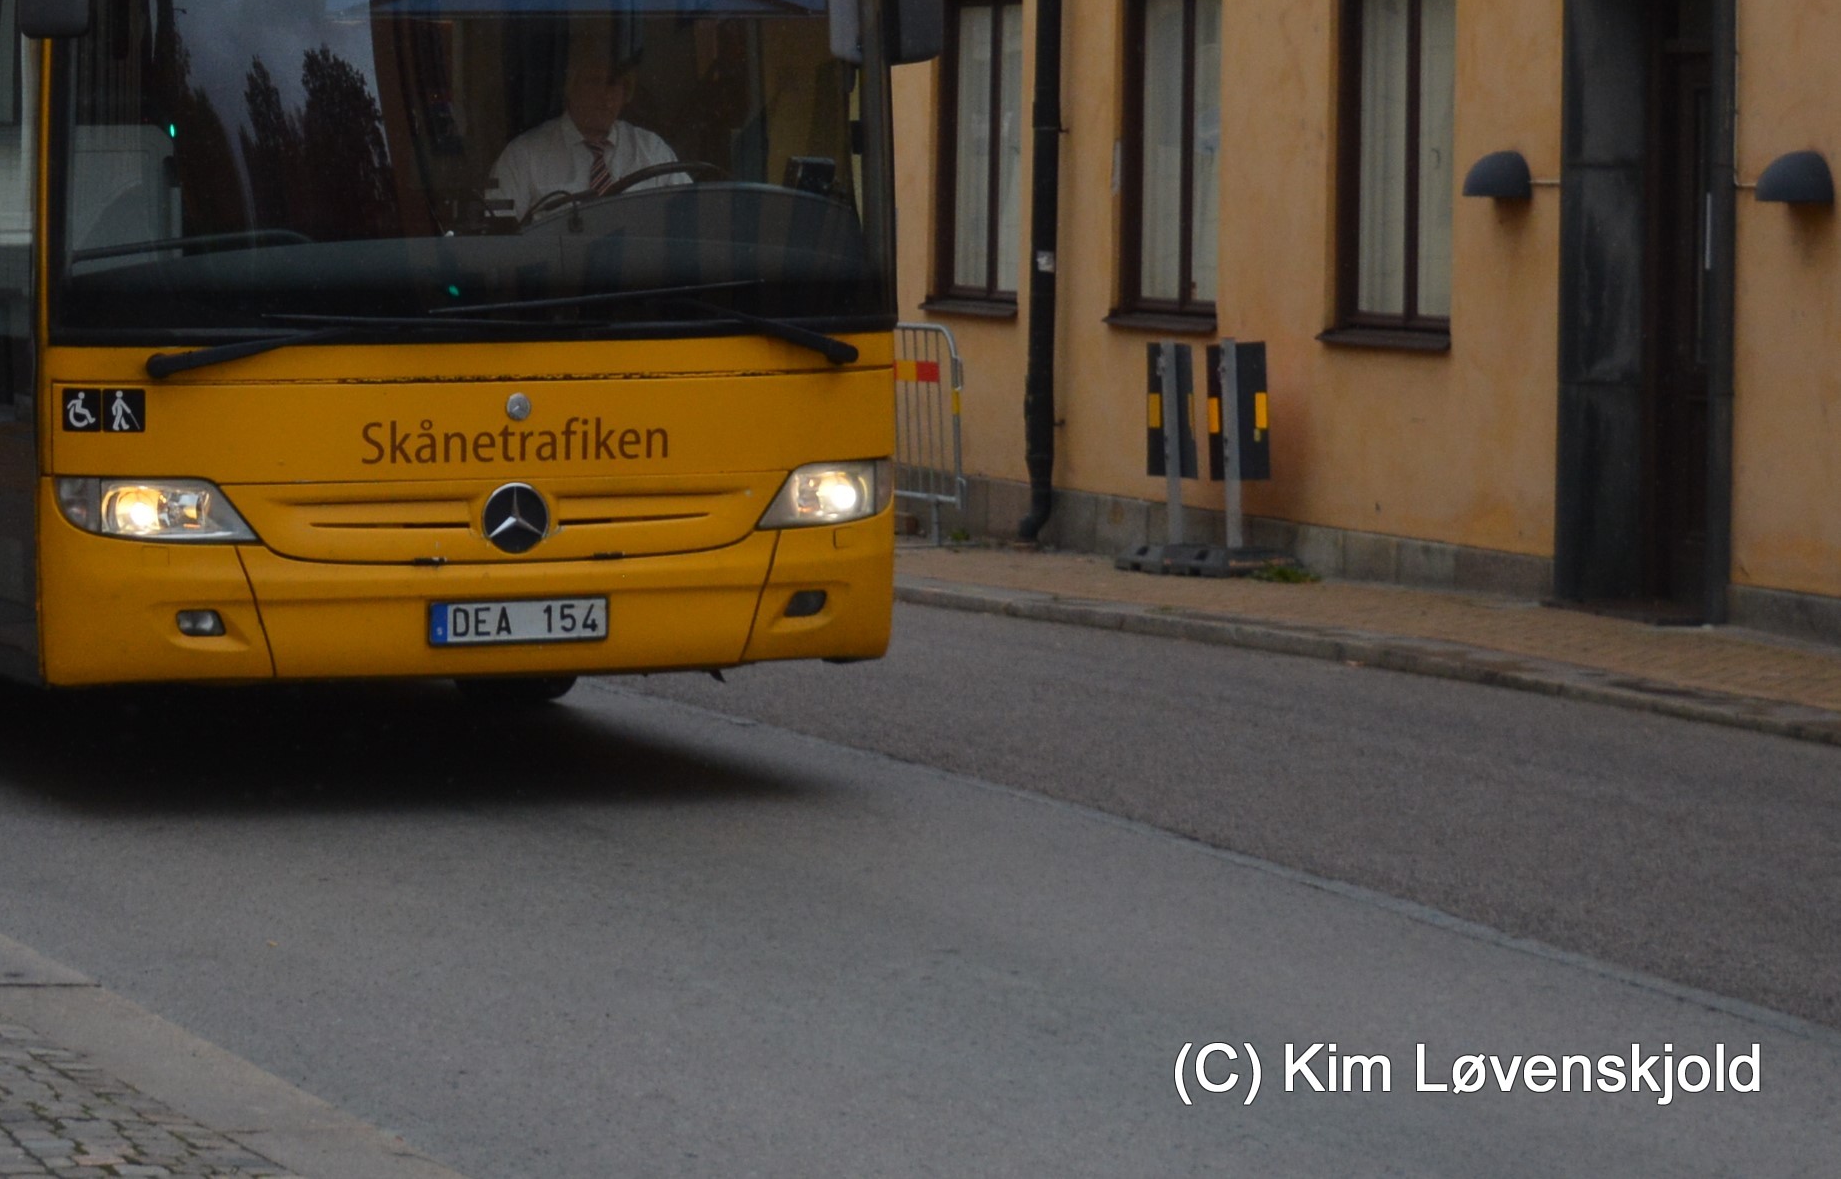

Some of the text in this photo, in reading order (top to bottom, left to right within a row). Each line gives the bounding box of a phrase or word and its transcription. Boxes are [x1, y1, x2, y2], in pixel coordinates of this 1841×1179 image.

[361, 416, 670, 465] Skånetrafiken
[452, 603, 599, 638] DEA 154
